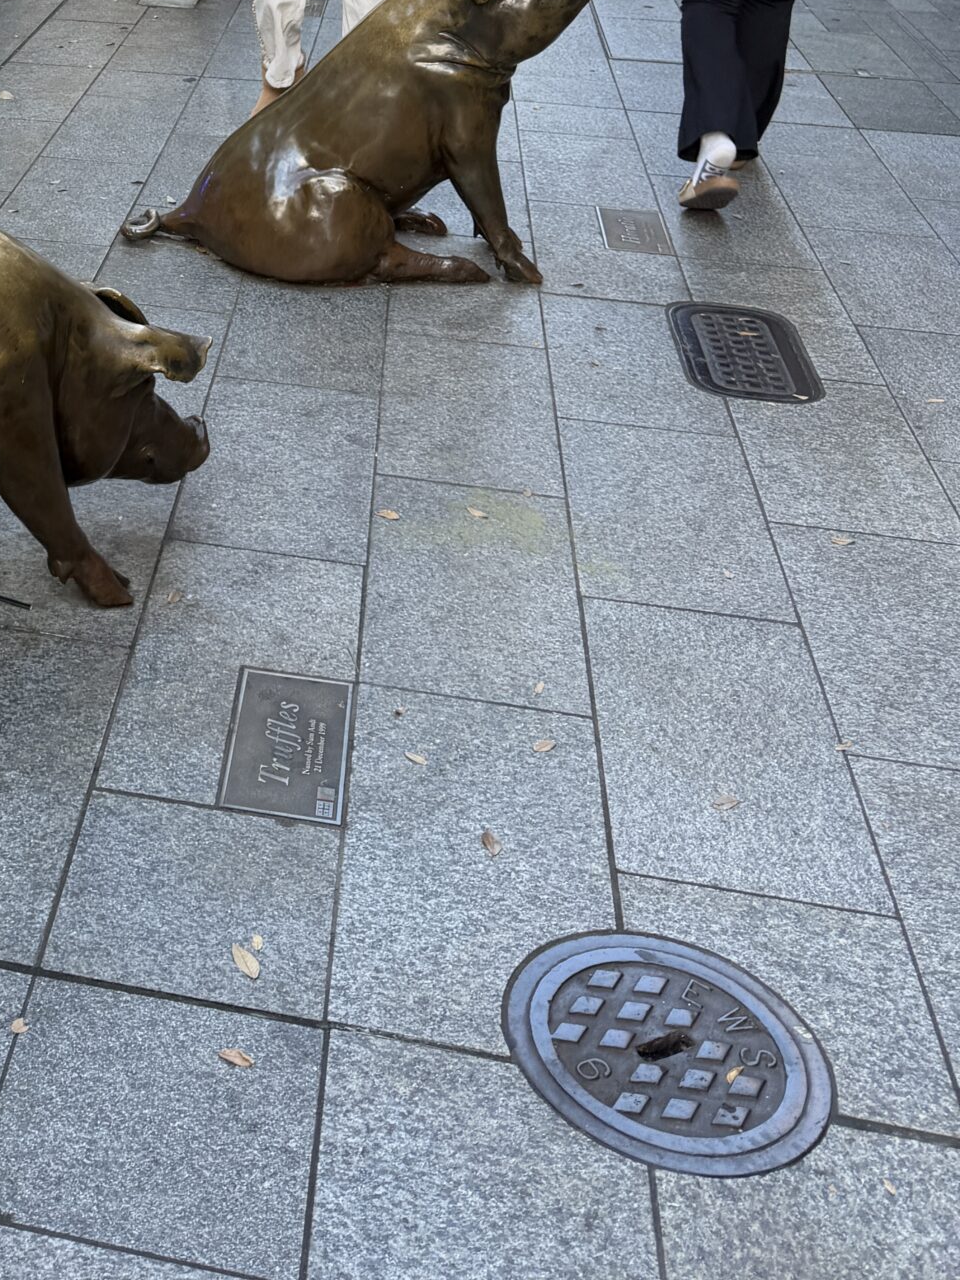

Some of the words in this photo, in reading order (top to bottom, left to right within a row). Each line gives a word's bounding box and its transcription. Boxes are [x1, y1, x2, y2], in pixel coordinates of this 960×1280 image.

[258, 701, 301, 786] Truffles
[314, 736, 325, 764] December
[302, 753, 312, 775] Named
[314, 765, 322, 773] 21
